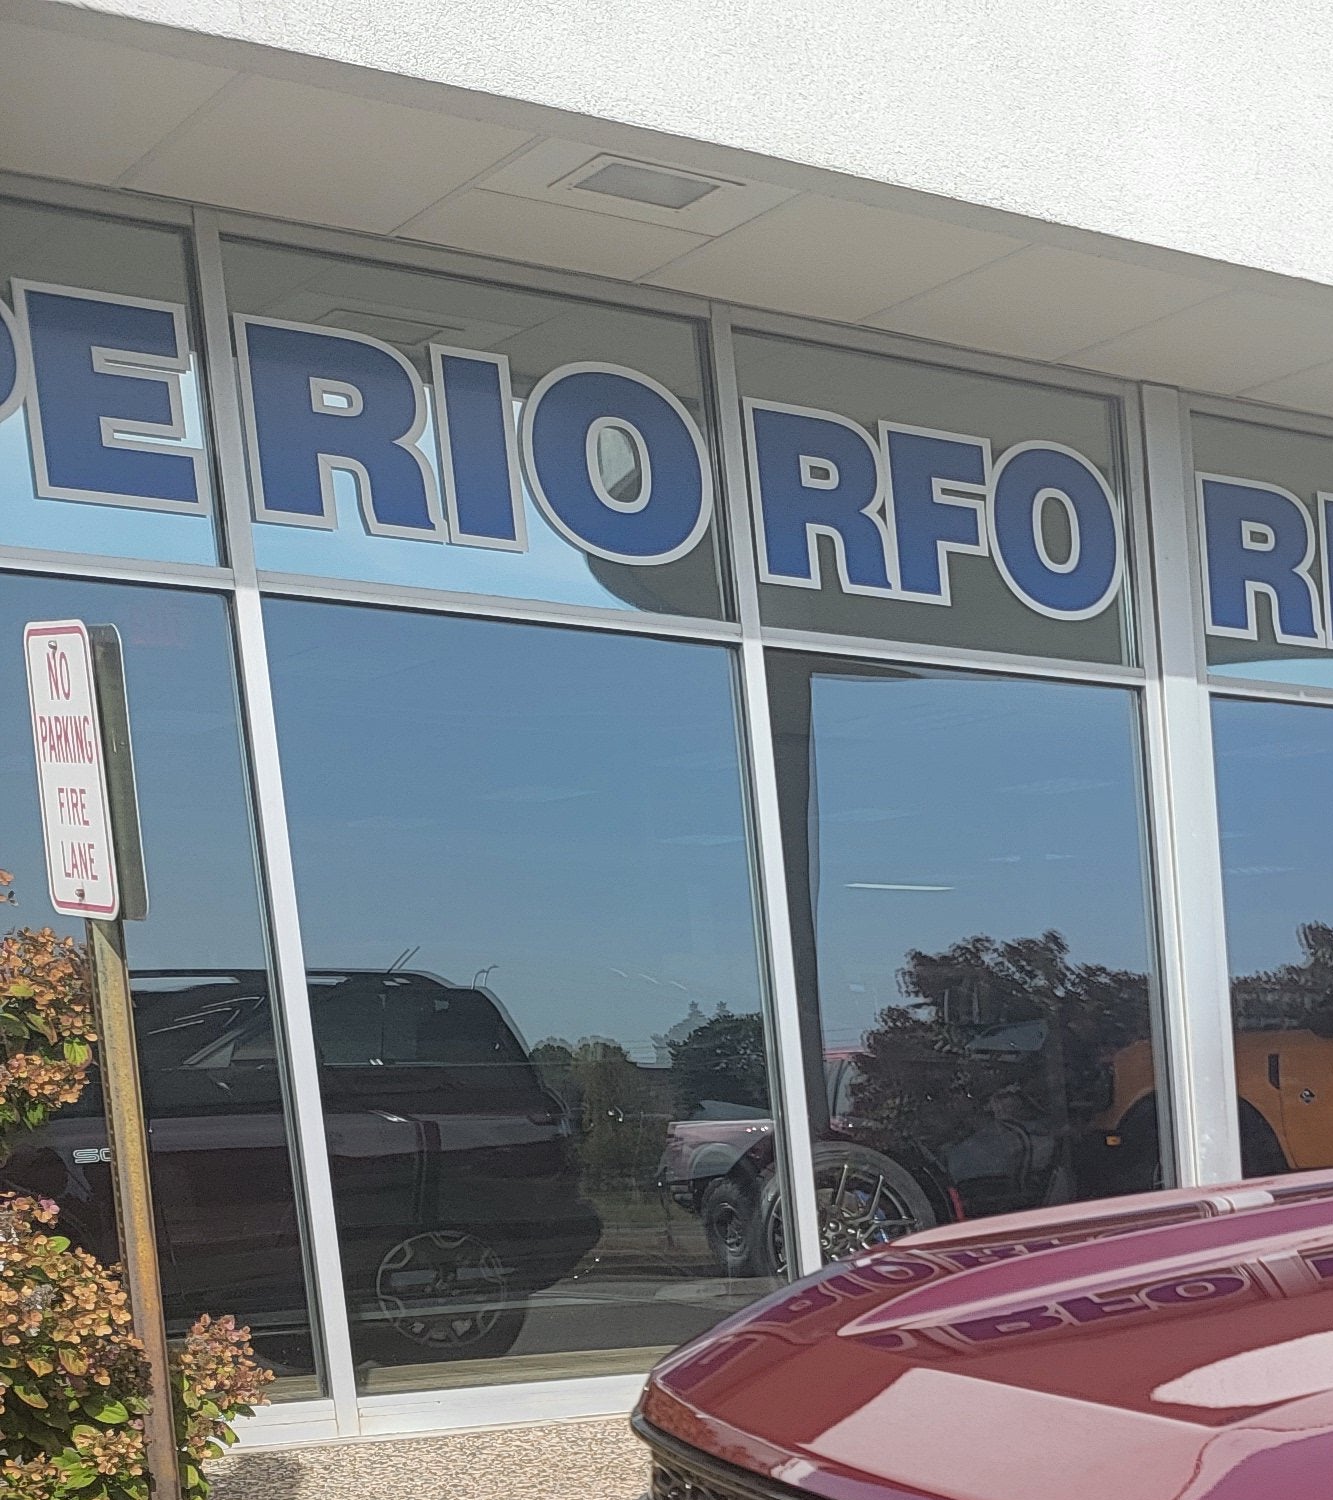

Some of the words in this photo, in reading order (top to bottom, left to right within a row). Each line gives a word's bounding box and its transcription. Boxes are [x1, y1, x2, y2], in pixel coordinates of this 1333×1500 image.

[47, 651, 71, 701] NO
[39, 715, 94, 765] PARKING
[58, 787, 90, 827] FIRE
[61, 841, 98, 881] LANE
